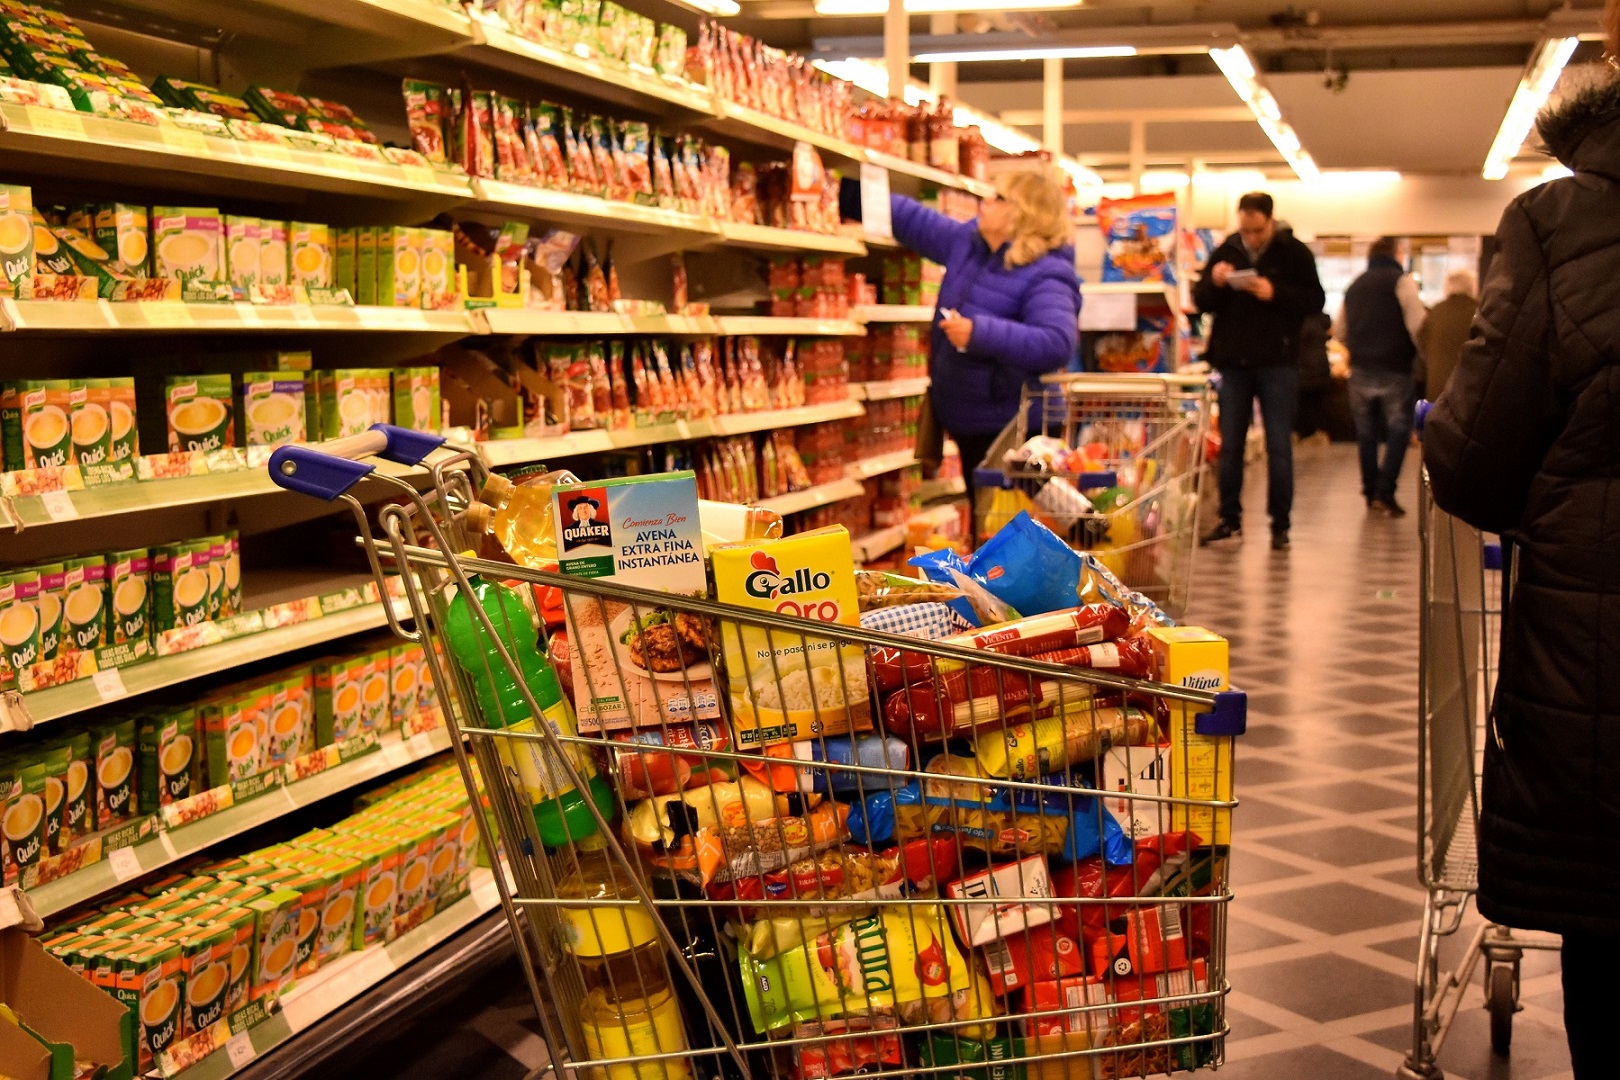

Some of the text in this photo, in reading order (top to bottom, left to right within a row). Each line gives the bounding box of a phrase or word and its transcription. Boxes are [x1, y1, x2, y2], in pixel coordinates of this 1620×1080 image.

[6, 258, 30, 281] Quick
[175, 265, 206, 281] Quick
[188, 434, 221, 452] Quick
[263, 426, 292, 442] Quick
[40, 449, 66, 469] Quick
[81, 446, 105, 465] Quick
[113, 442, 131, 461] uick
[622, 512, 687, 530] Comienza Bien
[564, 525, 610, 541] QUAKER
[635, 529, 677, 543] AVENA
[622, 539, 693, 557] EXTRA FINA
[618, 552, 700, 570] INSTANTÁNEA
[746, 568, 830, 599] Gallo
[126, 614, 144, 636] Quick
[186, 606, 205, 627] Quick
[44, 632, 57, 653] uick
[78, 624, 99, 647] Quick
[982, 632, 1015, 645] VICENTE
[12, 644, 36, 669] Quick
[757, 650, 770, 659] No
[807, 641, 816, 651] ni
[818, 641, 828, 650] se
[829, 639, 852, 652] pga
[1182, 676, 1221, 689] Vitina
[171, 773, 189, 796] Quick
[109, 784, 130, 809] Quick
[17, 836, 40, 864] Quick
[761, 977, 769, 991] AGD
[118, 989, 136, 1001] Quick
[229, 987, 242, 1005] uick
[198, 1002, 221, 1029] Quick
[153, 1020, 175, 1049] Quick
